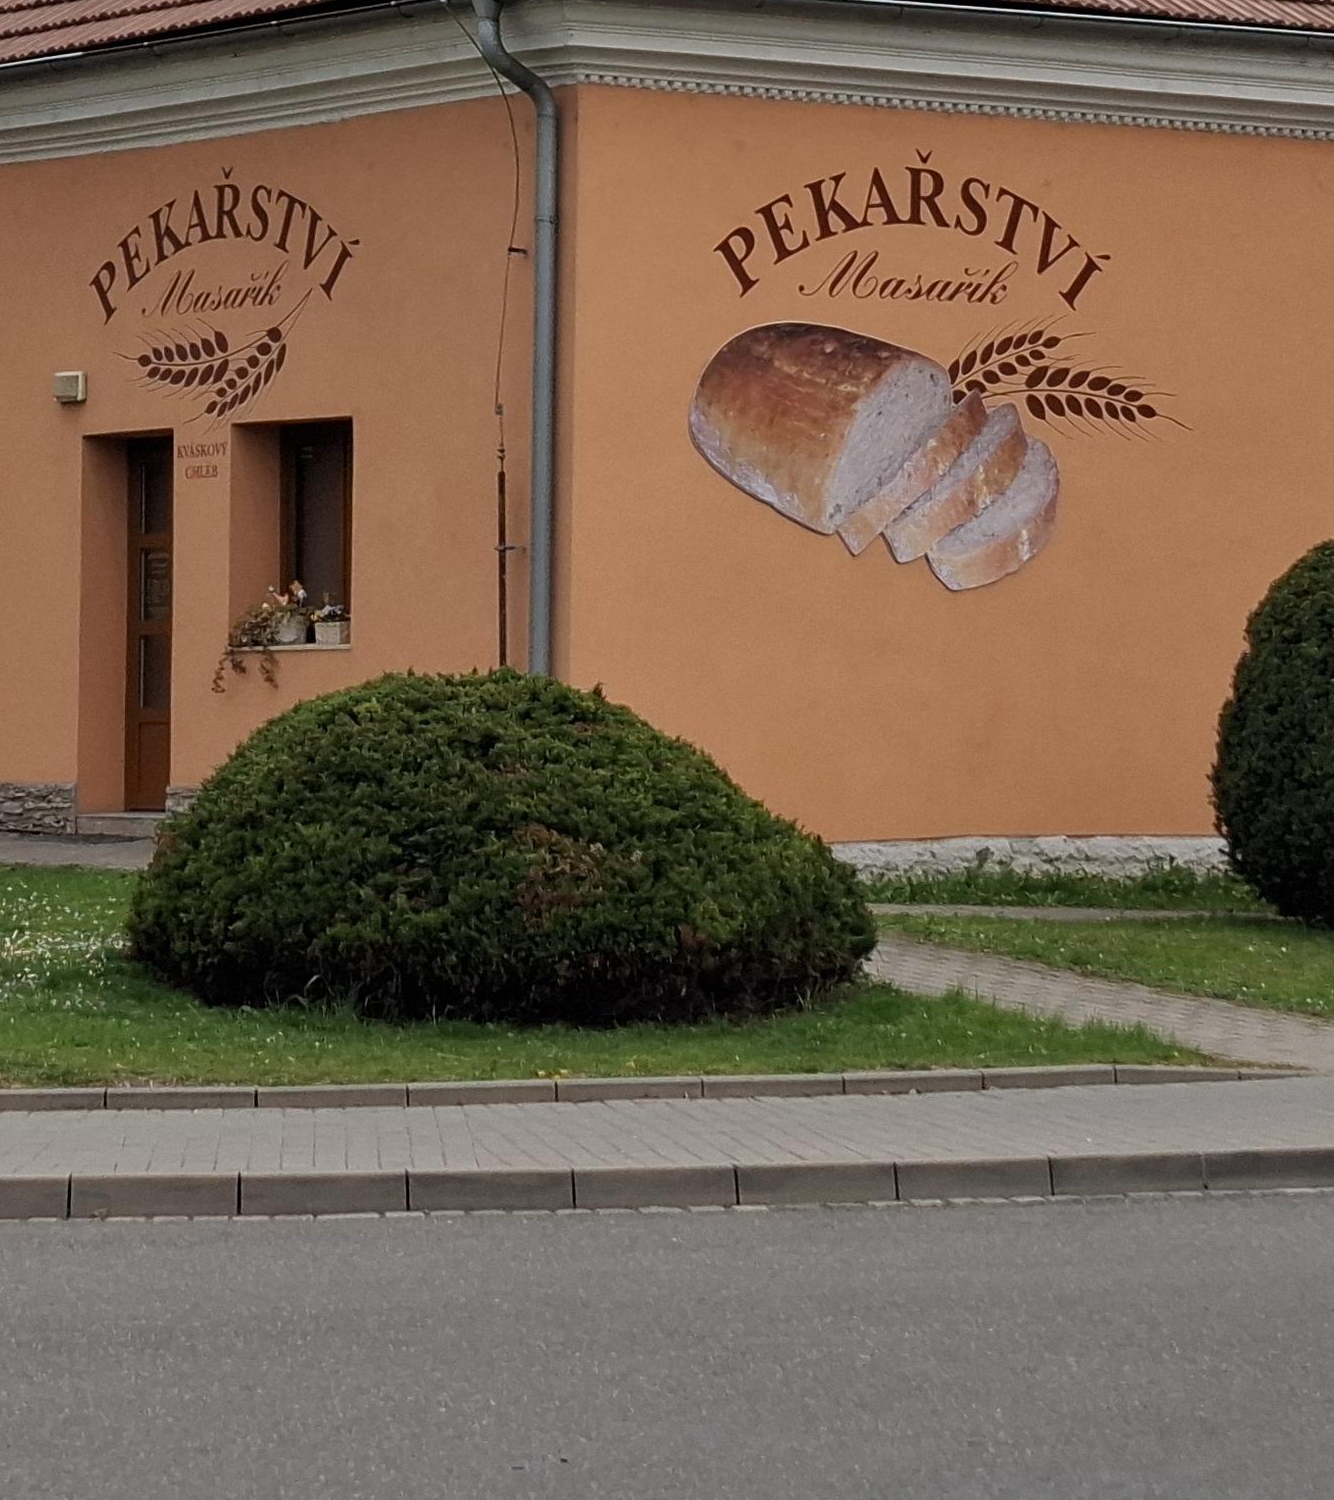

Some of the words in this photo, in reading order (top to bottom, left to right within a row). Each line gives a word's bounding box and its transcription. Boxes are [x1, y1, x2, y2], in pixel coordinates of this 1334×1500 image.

[89, 166, 361, 326] PEKAŘSTVÍ
[713, 148, 1111, 311] PEKAŘSTVÍ
[798, 250, 1019, 305] Masařík
[141, 260, 289, 317] Masařík
